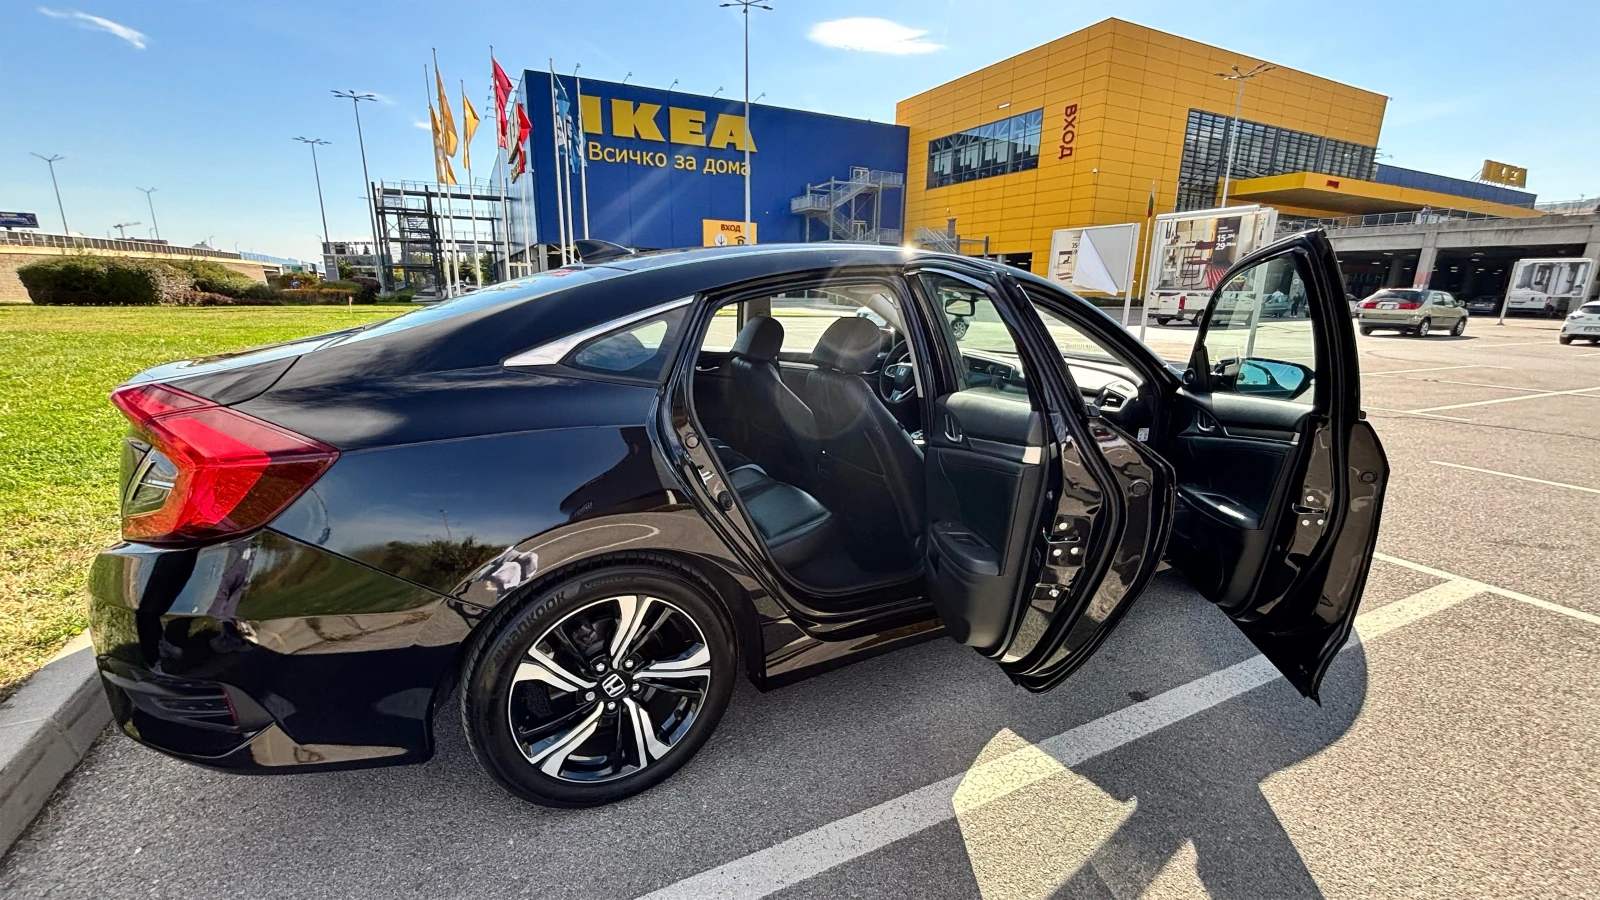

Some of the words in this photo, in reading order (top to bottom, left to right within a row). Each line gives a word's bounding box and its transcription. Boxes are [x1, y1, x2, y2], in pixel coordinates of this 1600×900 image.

[580, 94, 757, 152] IKEA
[1058, 104, 1077, 159] ВХОД
[588, 141, 667, 168] Всичко
[674, 154, 697, 171] за
[720, 224, 741, 233] ВХОД
